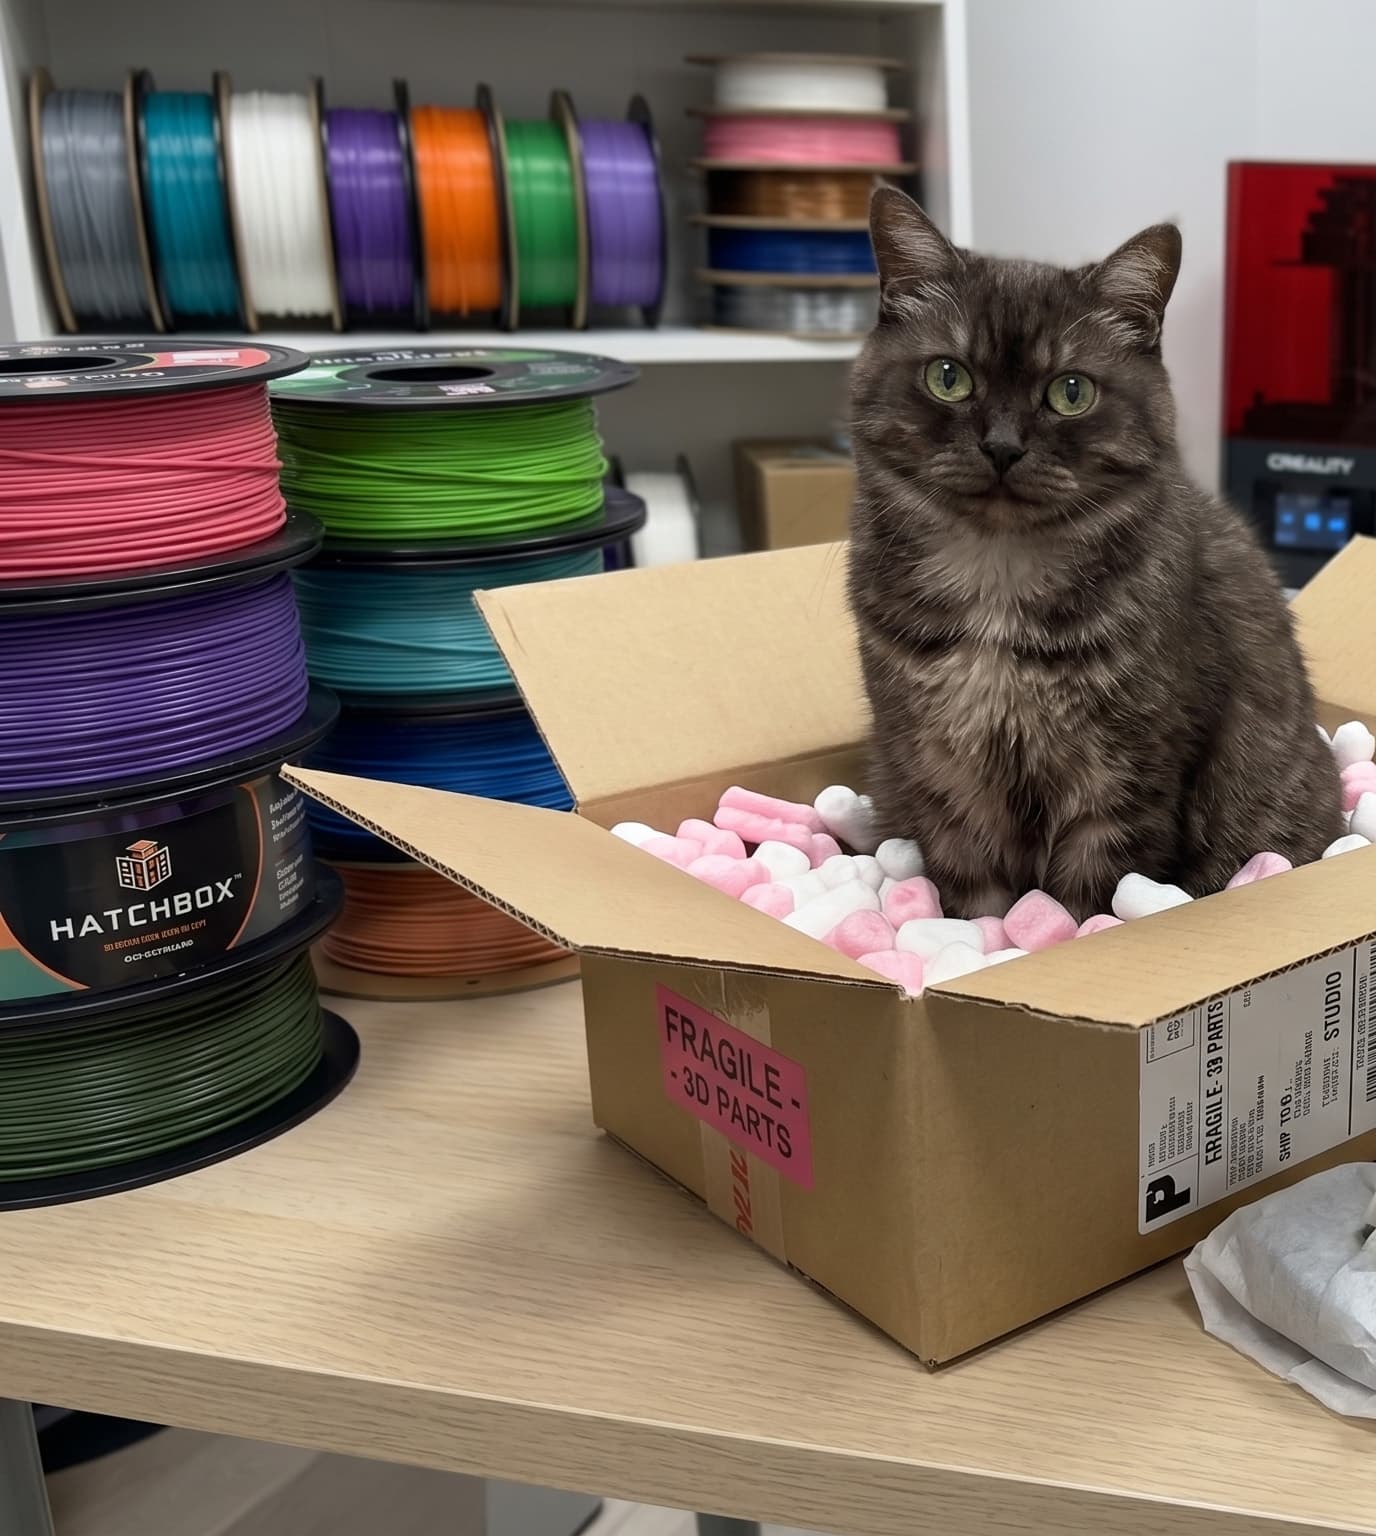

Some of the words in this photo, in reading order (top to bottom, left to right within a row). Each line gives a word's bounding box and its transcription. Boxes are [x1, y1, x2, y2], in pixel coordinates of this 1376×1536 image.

[1265, 452, 1355, 476] CREALITY
[50, 877, 235, 941] HATCHBOX
[1207, 1000, 1223, 1054] PARTS
[1324, 971, 1342, 1042] STUDIO
[665, 1005, 783, 1110] FRAGILE
[683, 1066, 710, 1106] 3D
[716, 1085, 792, 1159] PARTS
[1279, 1131, 1291, 1162] SHIP
